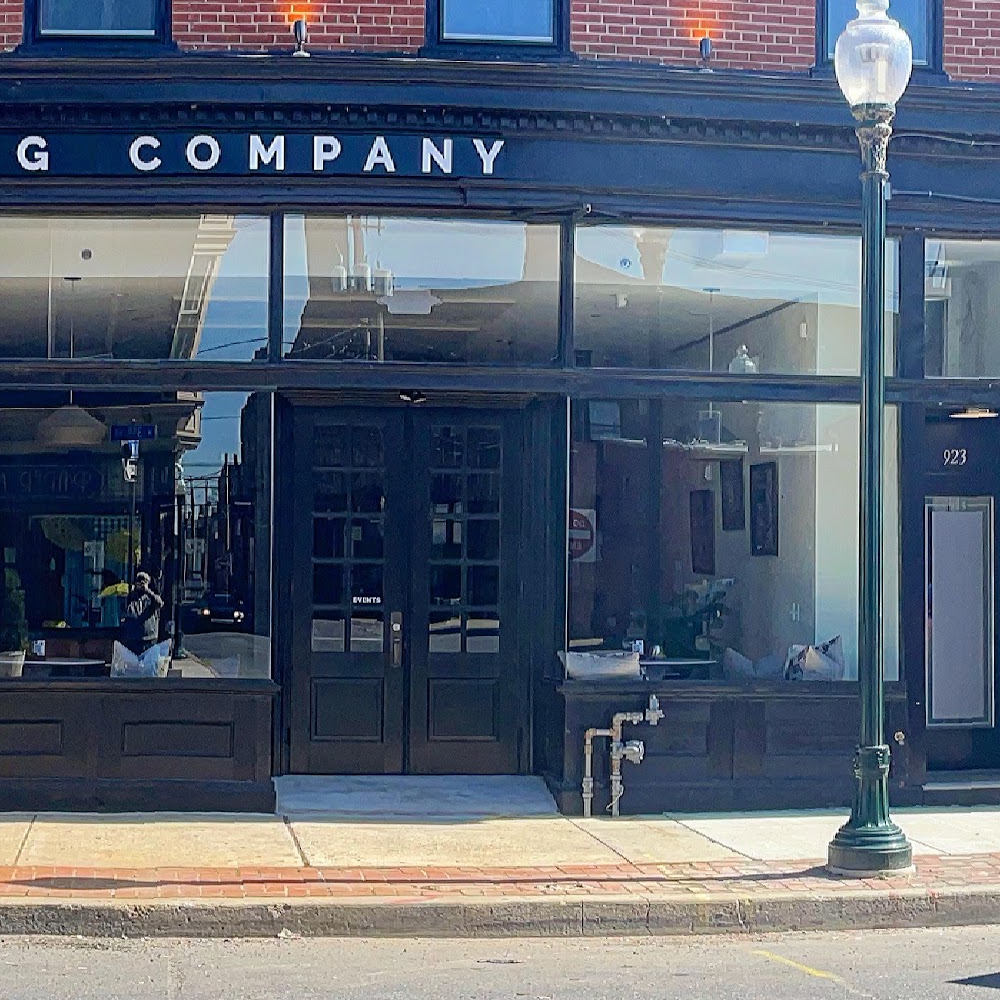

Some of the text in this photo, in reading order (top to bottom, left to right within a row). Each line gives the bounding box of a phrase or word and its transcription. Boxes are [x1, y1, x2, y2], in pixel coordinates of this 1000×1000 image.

[129, 135, 504, 175] COMPANY
[943, 448, 968, 466] 923
[352, 596, 382, 604] EVENTS
